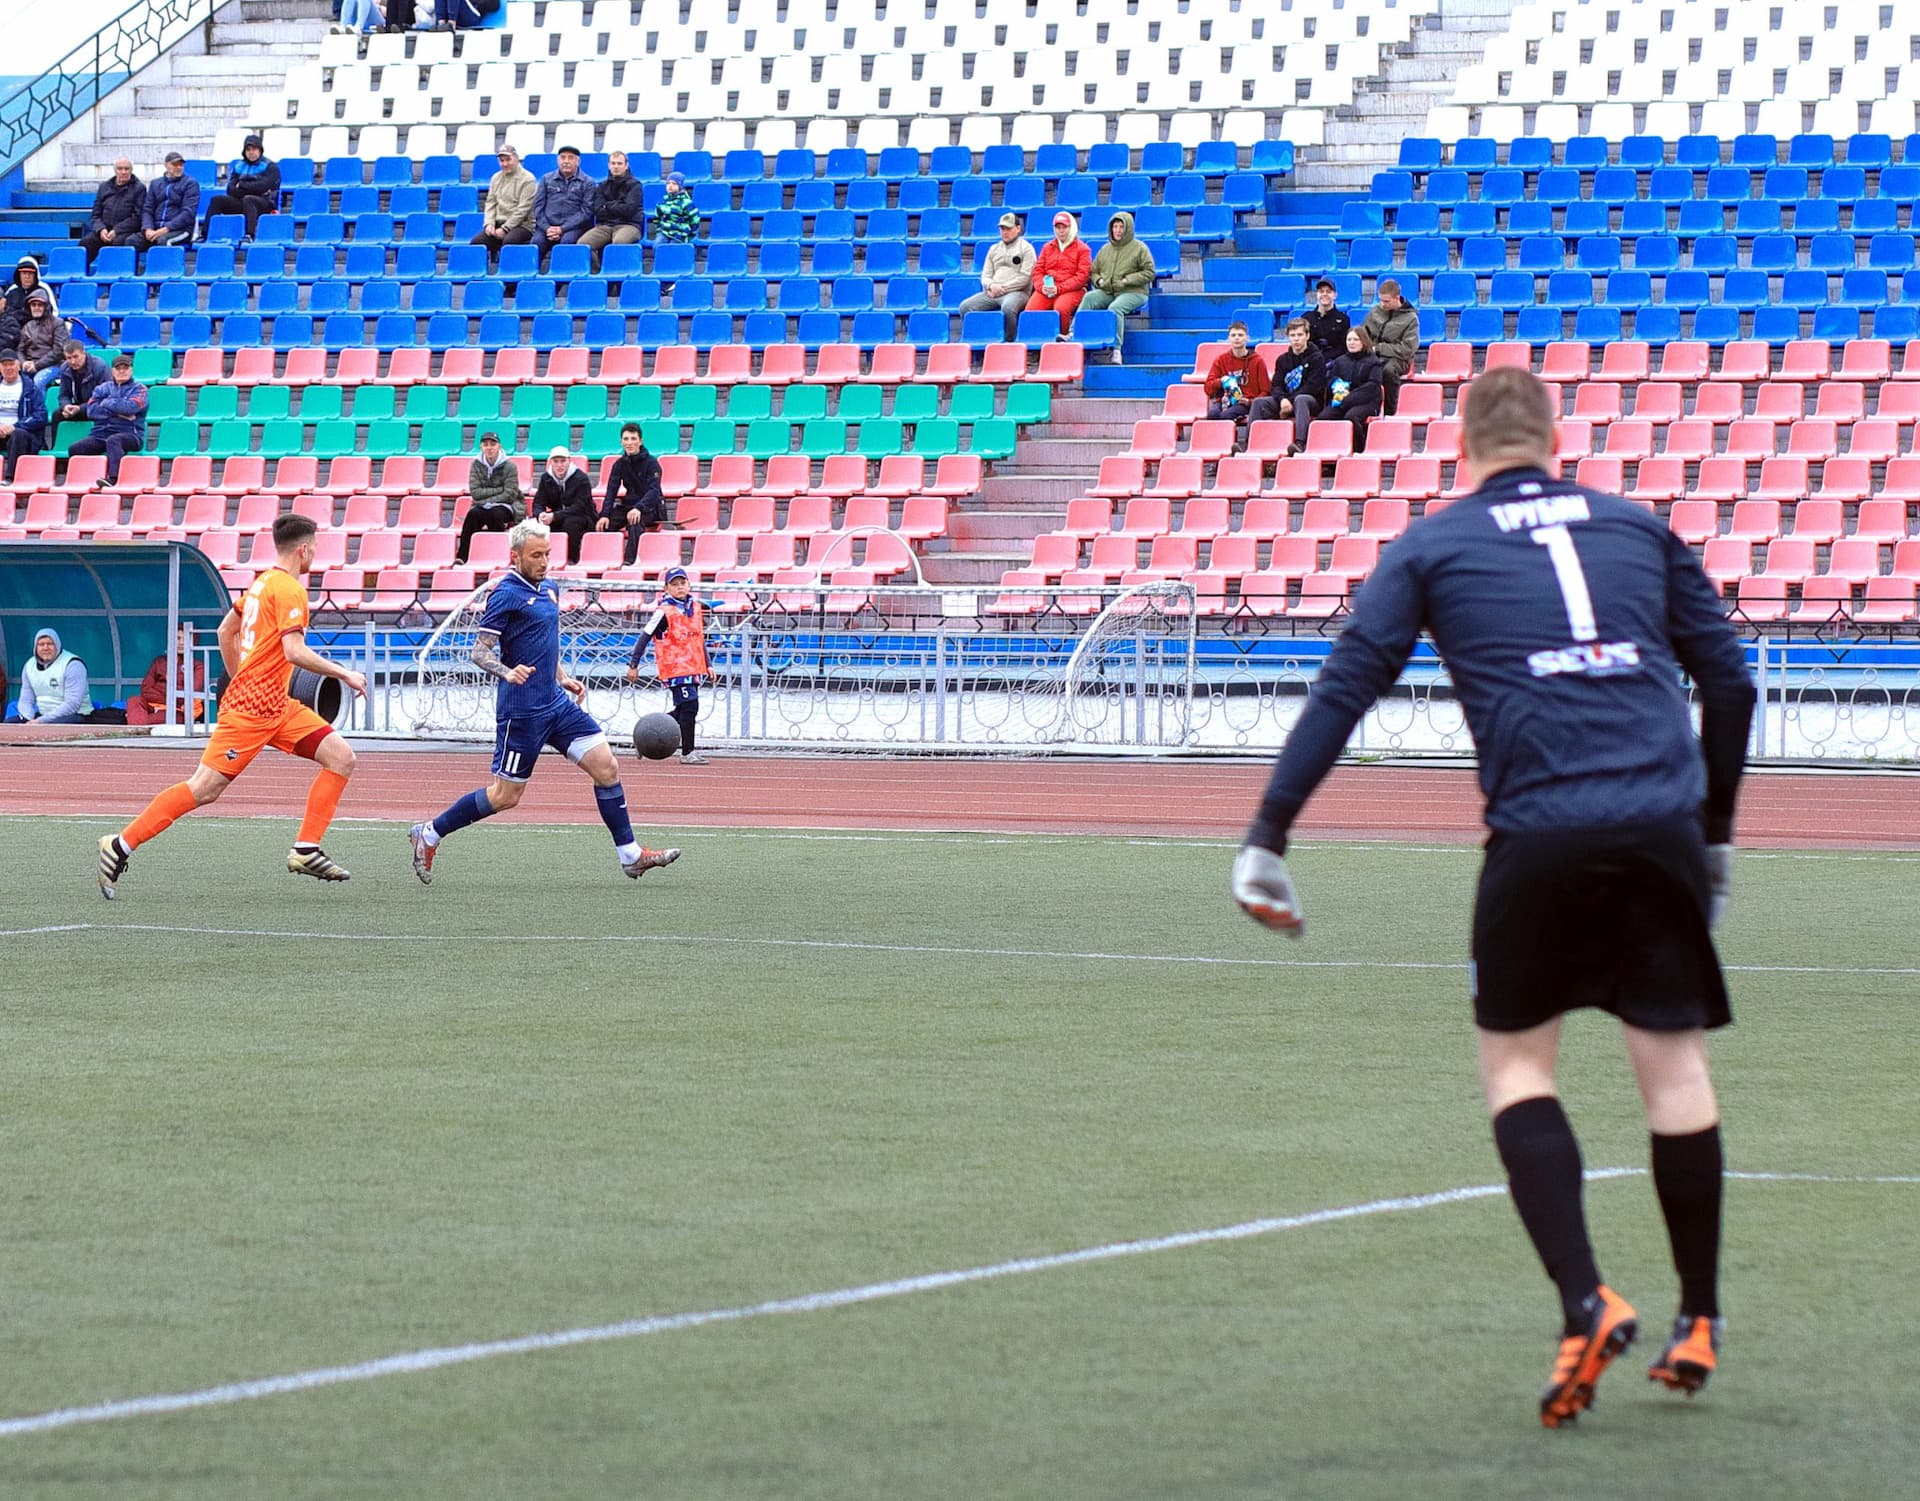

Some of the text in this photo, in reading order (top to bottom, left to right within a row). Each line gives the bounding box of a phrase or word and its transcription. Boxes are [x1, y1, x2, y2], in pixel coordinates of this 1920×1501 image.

[1530, 523, 1598, 641] 1
[681, 686, 689, 698] 5
[504, 750, 522, 774] 11
